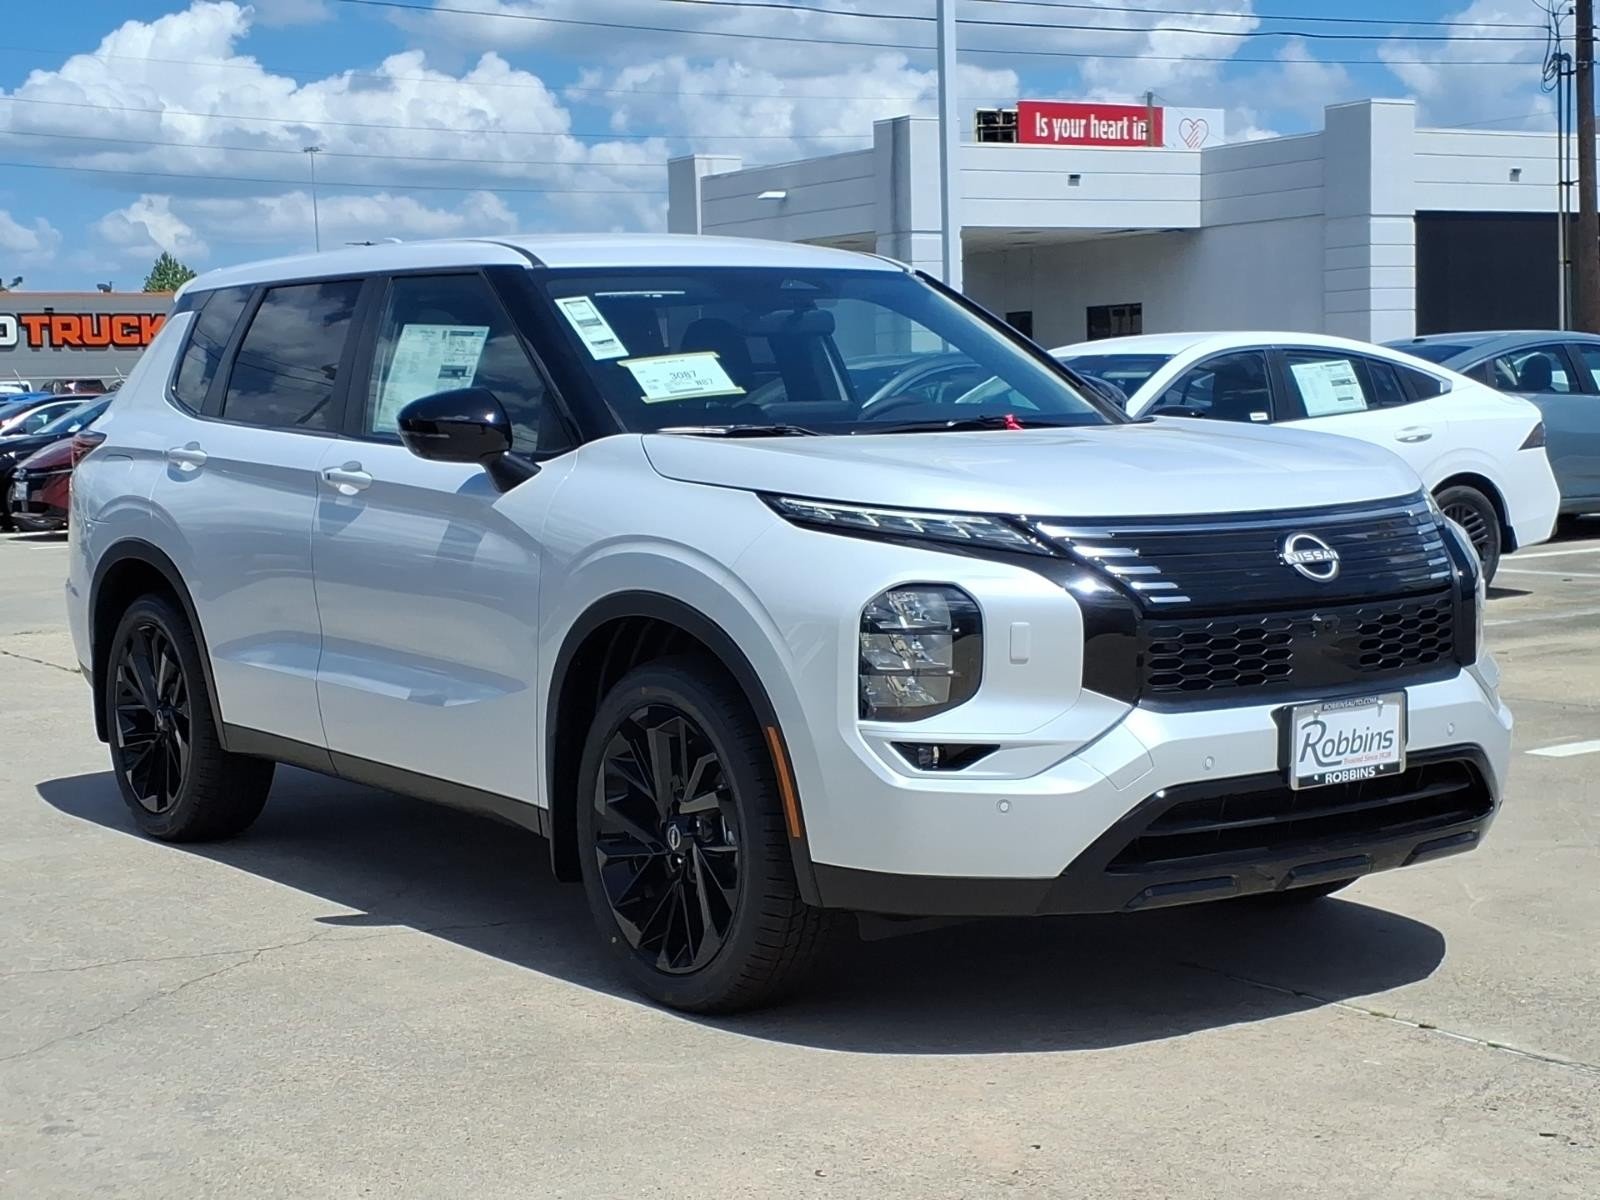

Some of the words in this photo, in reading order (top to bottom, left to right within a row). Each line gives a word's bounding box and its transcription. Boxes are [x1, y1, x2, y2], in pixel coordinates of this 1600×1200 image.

[1035, 111, 1048, 137] Is
[1052, 118, 1087, 142] your
[1090, 113, 1129, 140] heart
[1283, 548, 1339, 565] NISSAN
[1299, 720, 1394, 767] Robbins
[1325, 767, 1375, 784] ROBBINS
